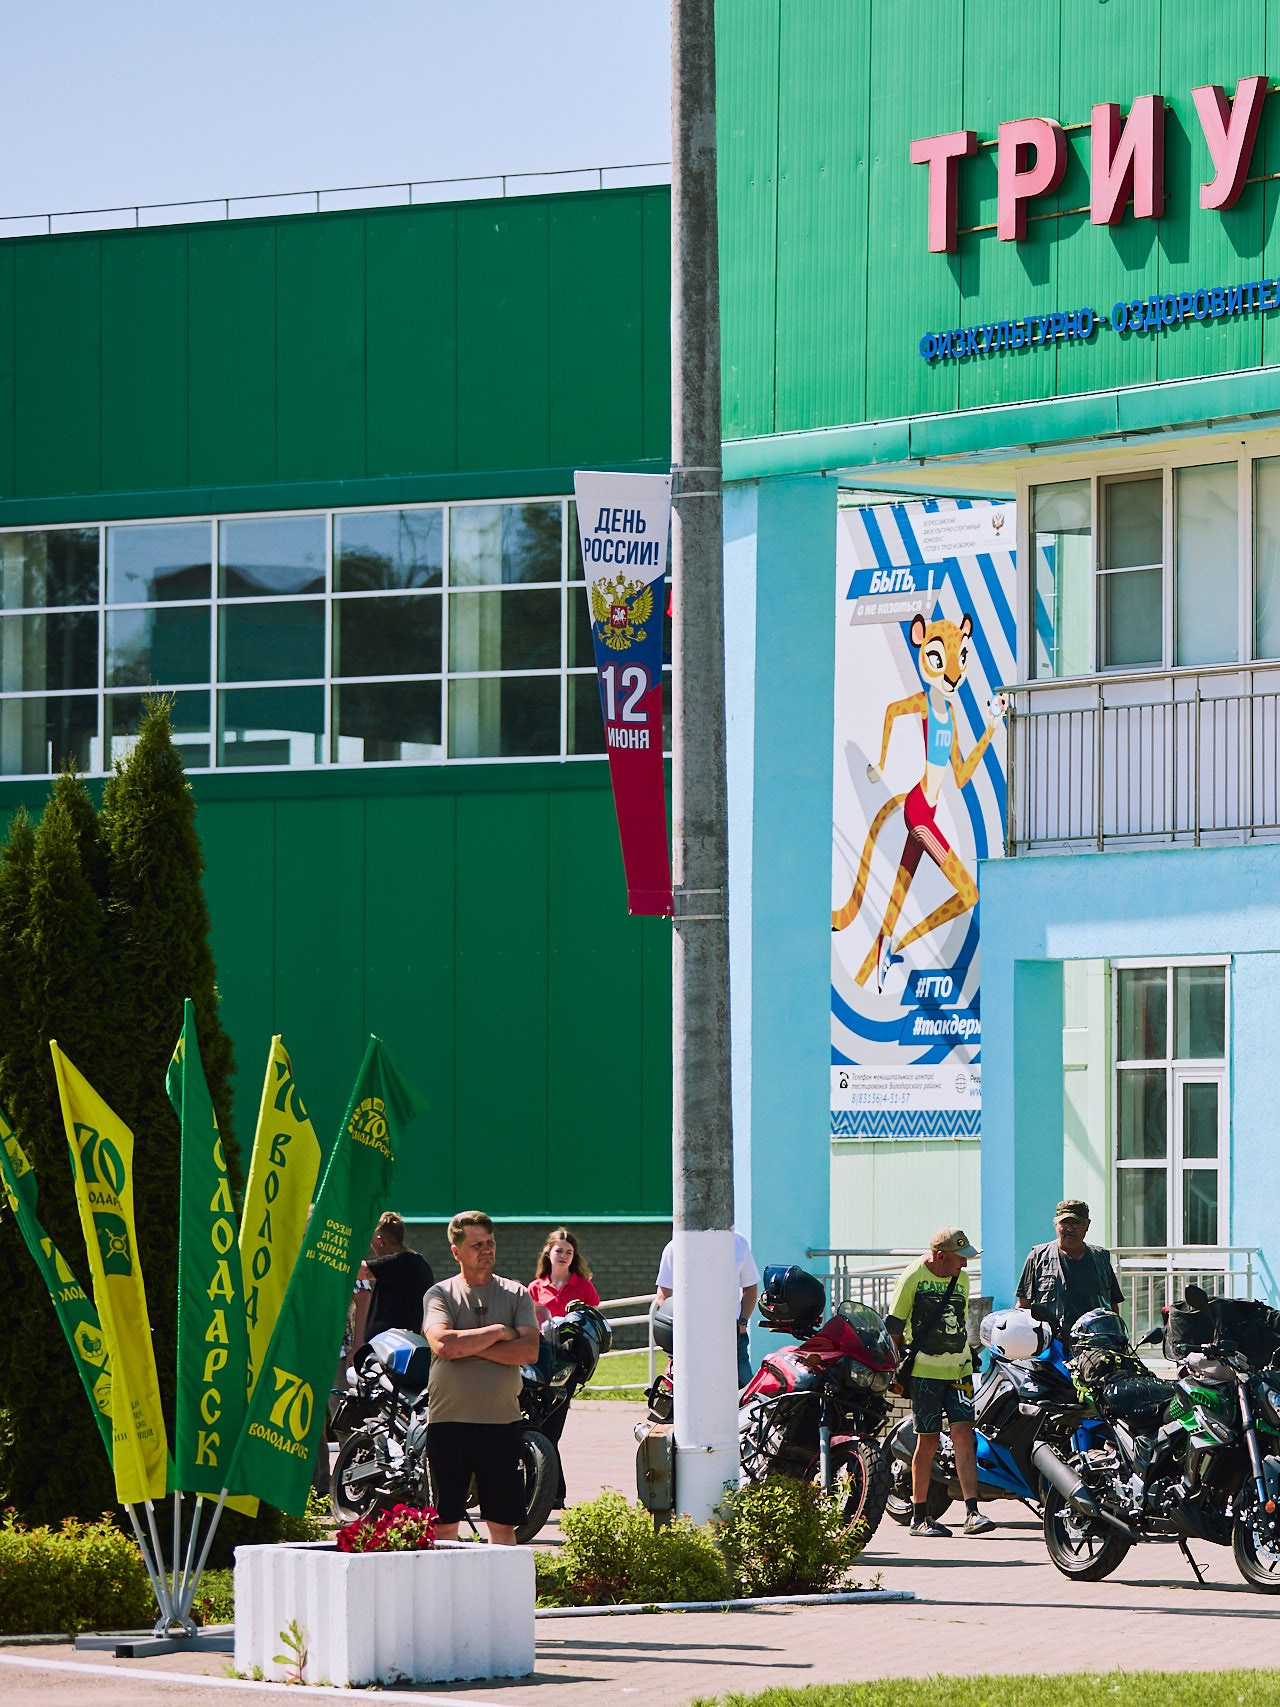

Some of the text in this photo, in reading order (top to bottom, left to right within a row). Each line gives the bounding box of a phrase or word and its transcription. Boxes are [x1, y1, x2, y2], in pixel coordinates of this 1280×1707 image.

[594, 508, 647, 534] ДЕНЬ
[584, 538, 659, 566] РОССИИ!
[869, 568, 916, 595] БЫТЬ,
[601, 665, 648, 722] 12
[607, 727, 650, 750] ИЮНЯ
[915, 975, 953, 998] #ГТО
[269, 1366, 314, 1442] 70
